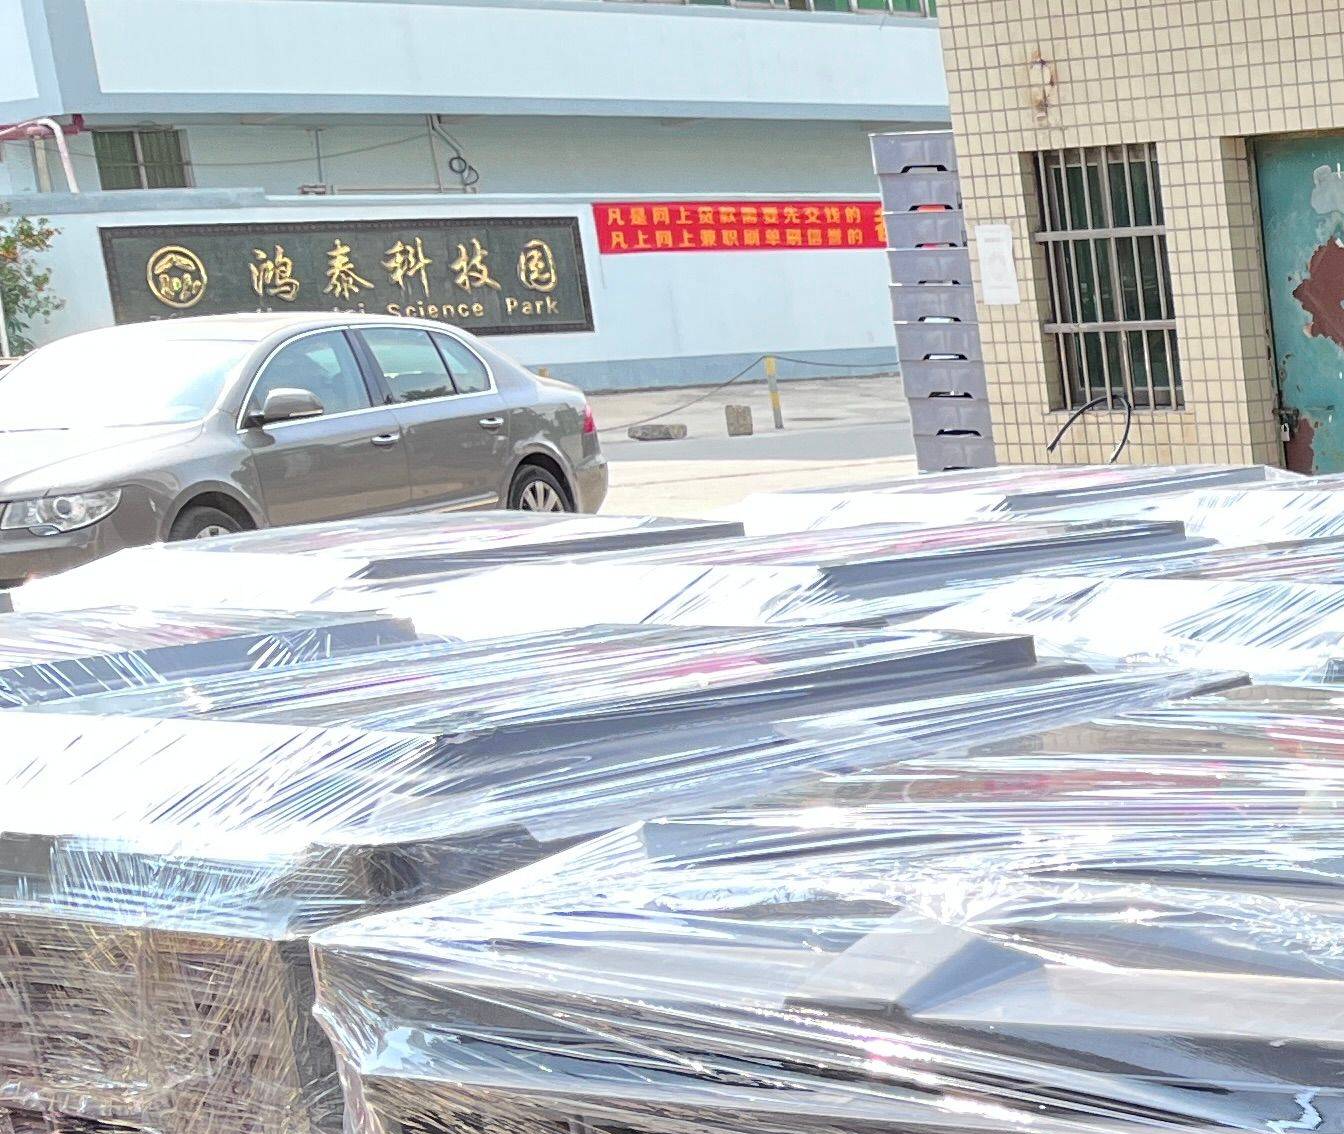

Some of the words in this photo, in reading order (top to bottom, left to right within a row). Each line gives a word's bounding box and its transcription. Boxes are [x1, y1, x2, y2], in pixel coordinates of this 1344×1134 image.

[250, 236, 558, 302] 鸿泰科技园
[386, 300, 485, 318] Science
[505, 295, 559, 315] Park
